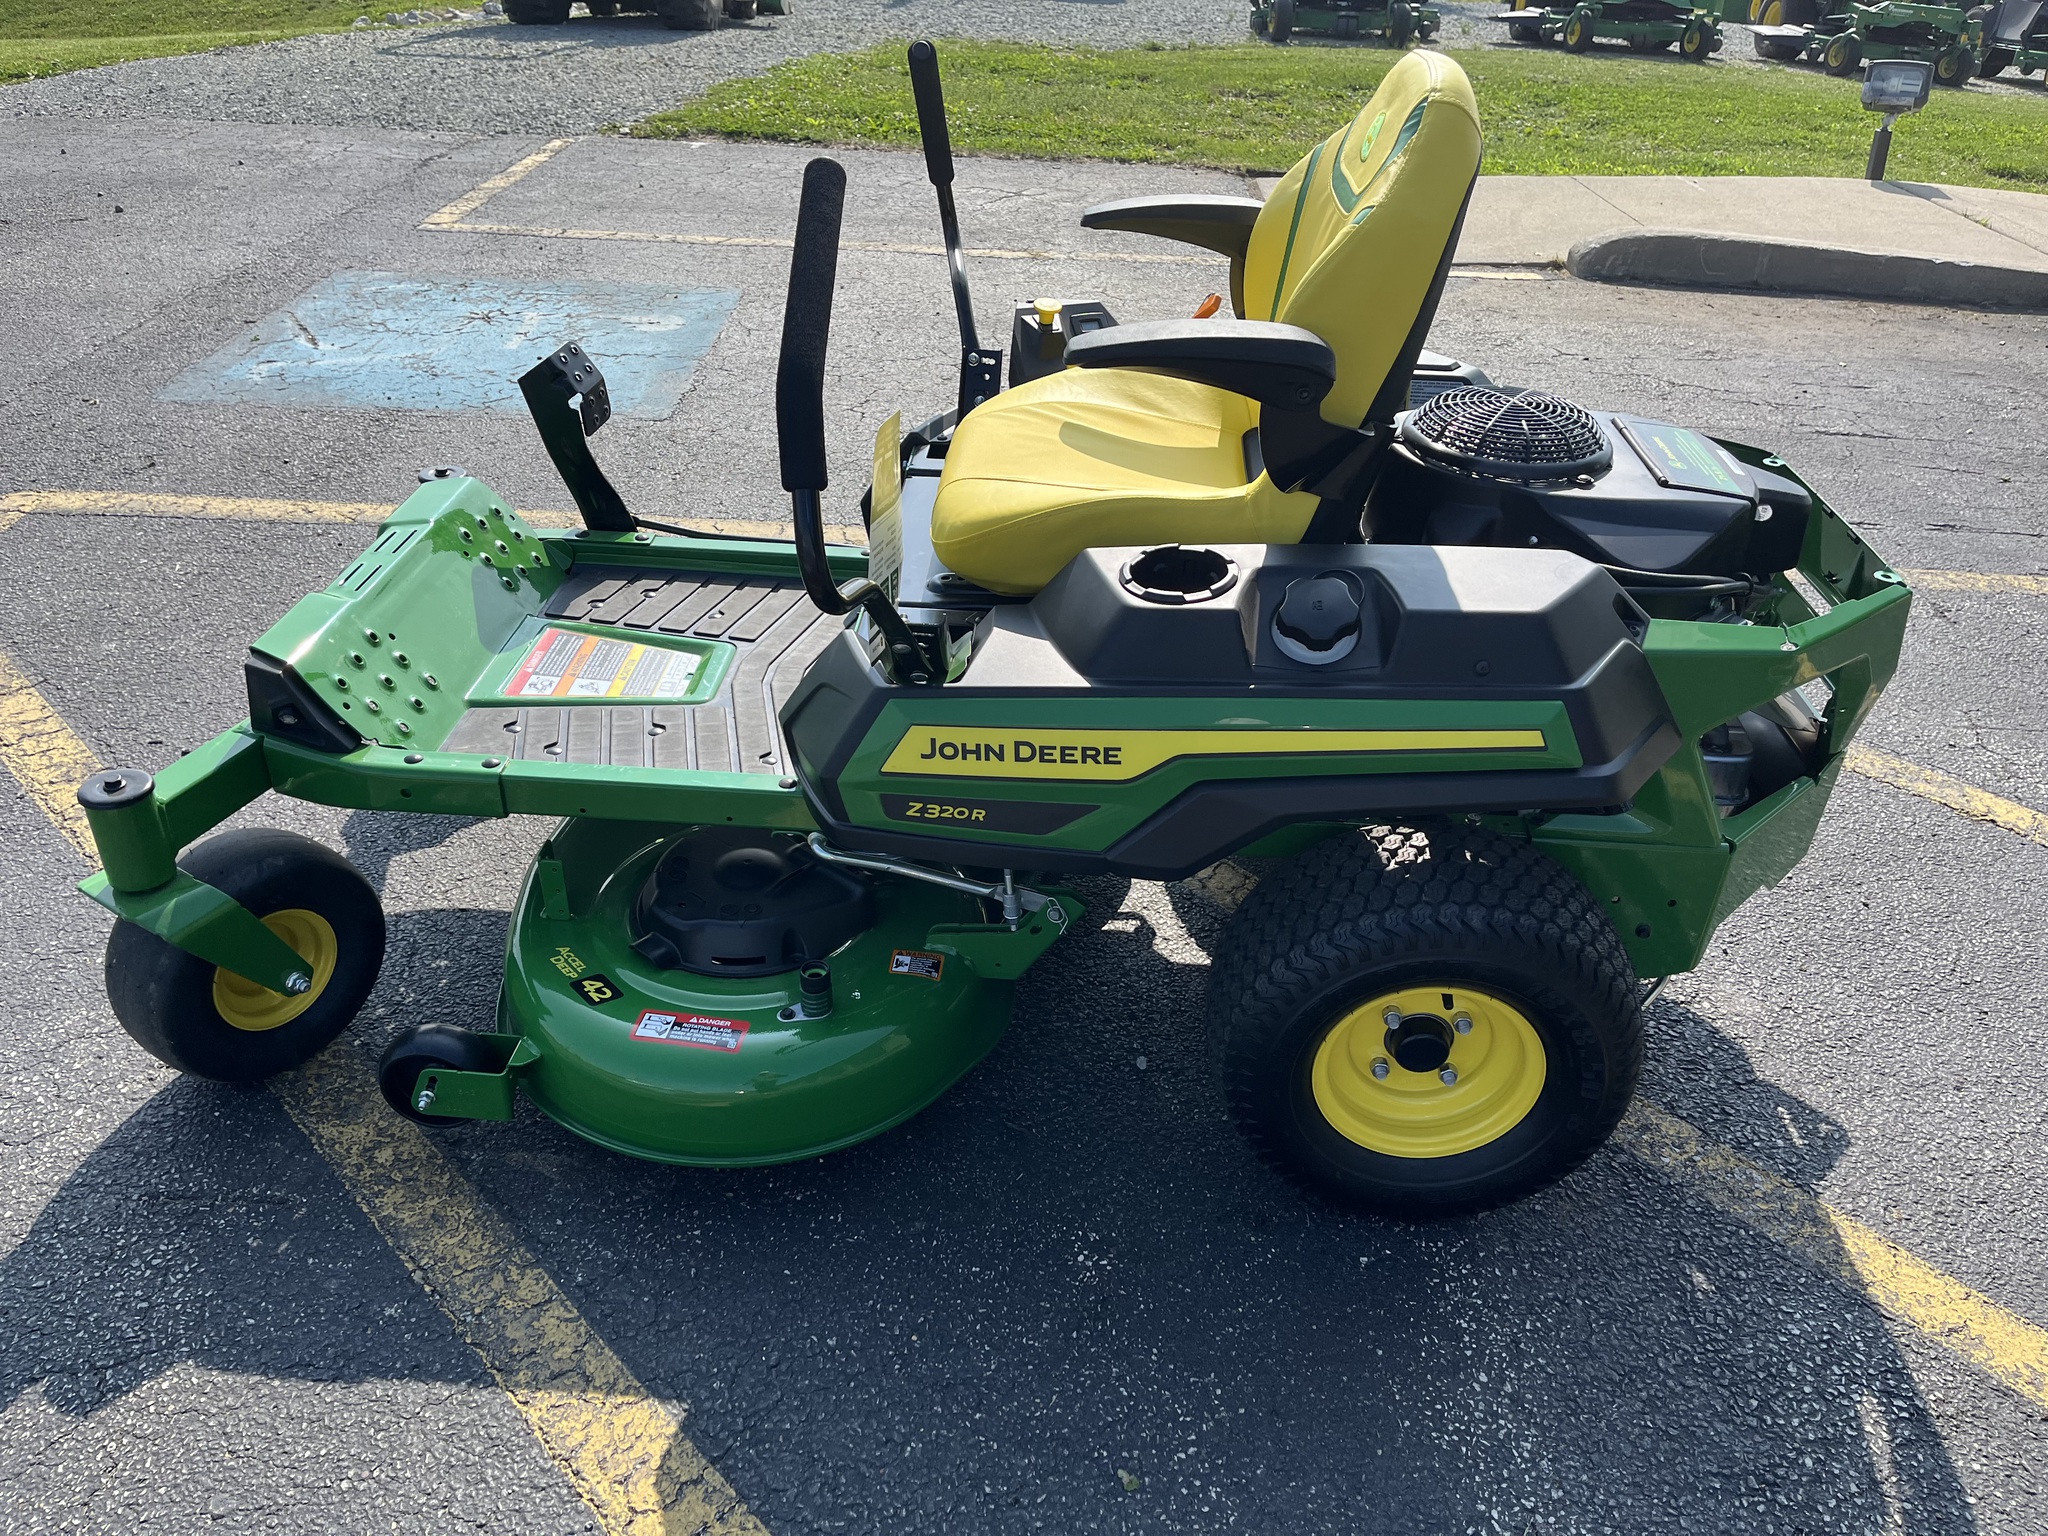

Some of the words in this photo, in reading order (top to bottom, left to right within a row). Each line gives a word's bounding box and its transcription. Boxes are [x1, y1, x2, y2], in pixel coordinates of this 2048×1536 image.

[920, 738, 1005, 762] JOHN
[1014, 740, 1122, 765] DEERE
[549, 955, 578, 978] DEEP
[555, 946, 586, 973] ACCEL
[581, 980, 613, 1002] 42
[682, 1023, 711, 1031] ROTATING
[699, 1018, 731, 1027] DANGER
